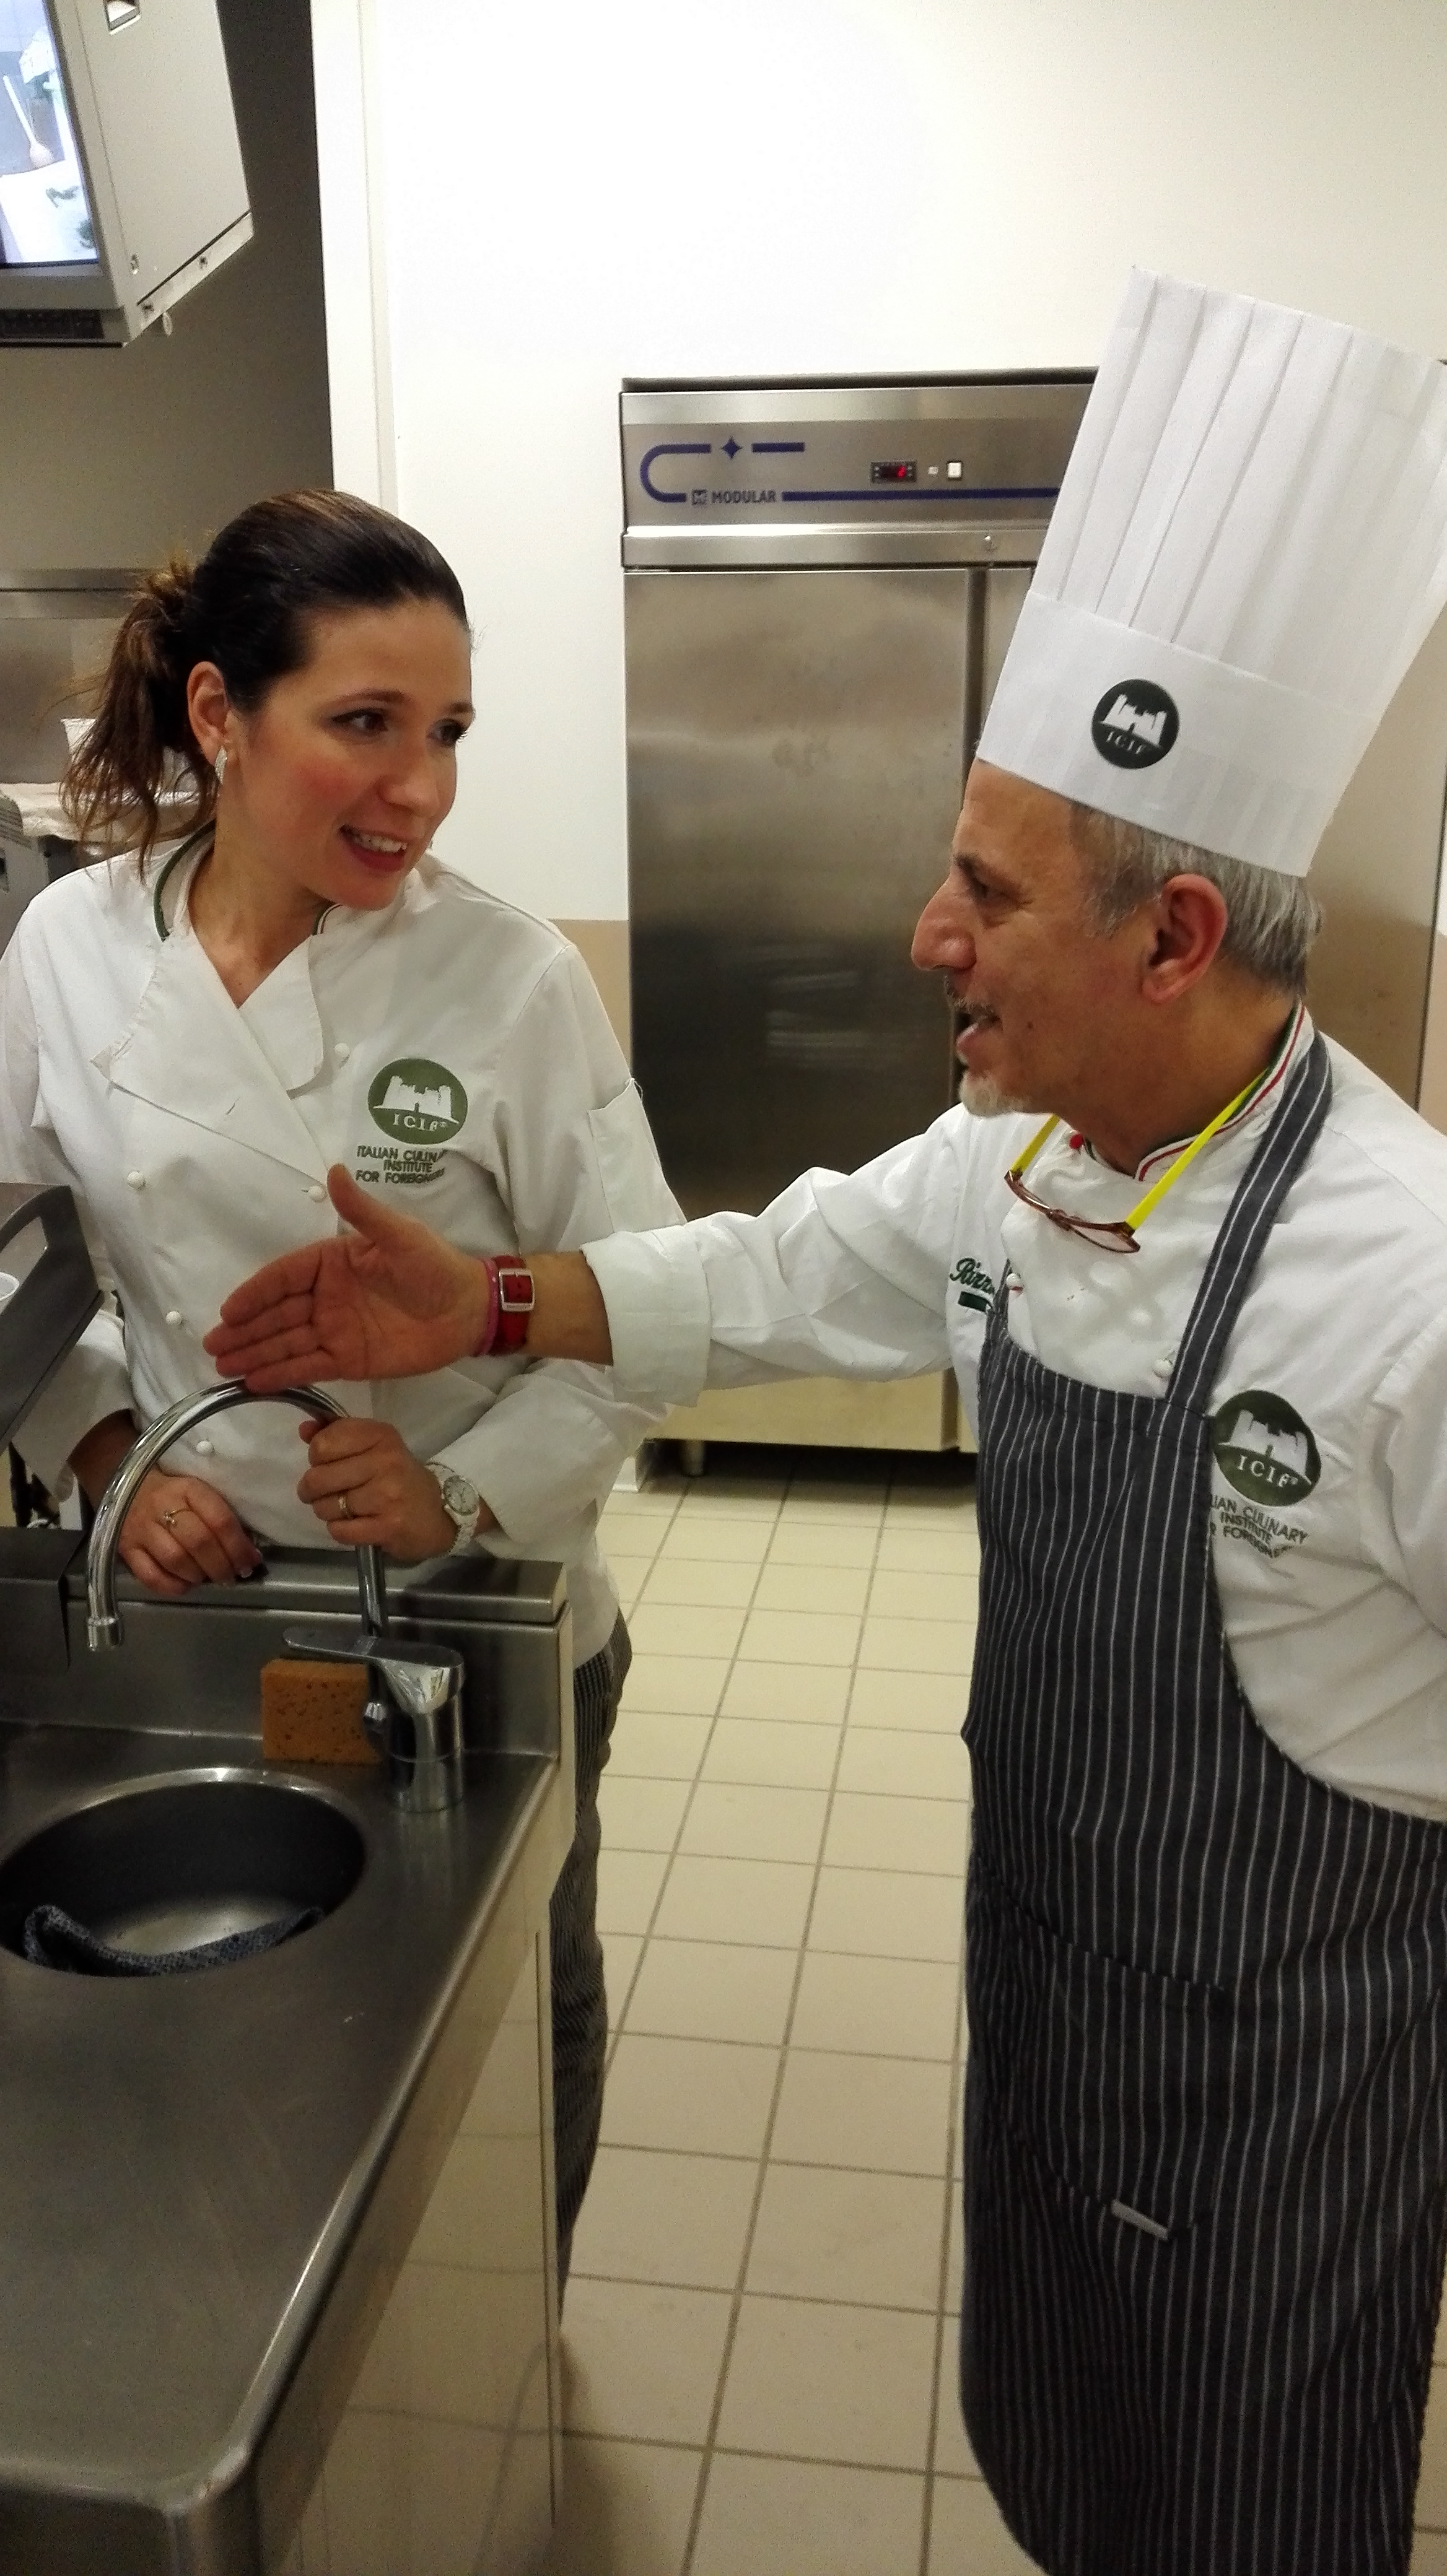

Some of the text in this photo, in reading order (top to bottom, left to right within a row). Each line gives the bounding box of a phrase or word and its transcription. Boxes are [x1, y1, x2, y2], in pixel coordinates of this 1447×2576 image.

[712, 490, 776, 503] MODULAR
[357, 1146, 398, 1160] ITALIAN
[383, 1159, 433, 1173] INSTITUTE
[356, 1170, 380, 1183] FOR
[1220, 1512, 1272, 1545] INSTITUTE
[1243, 1506, 1309, 1544] CULINARY
